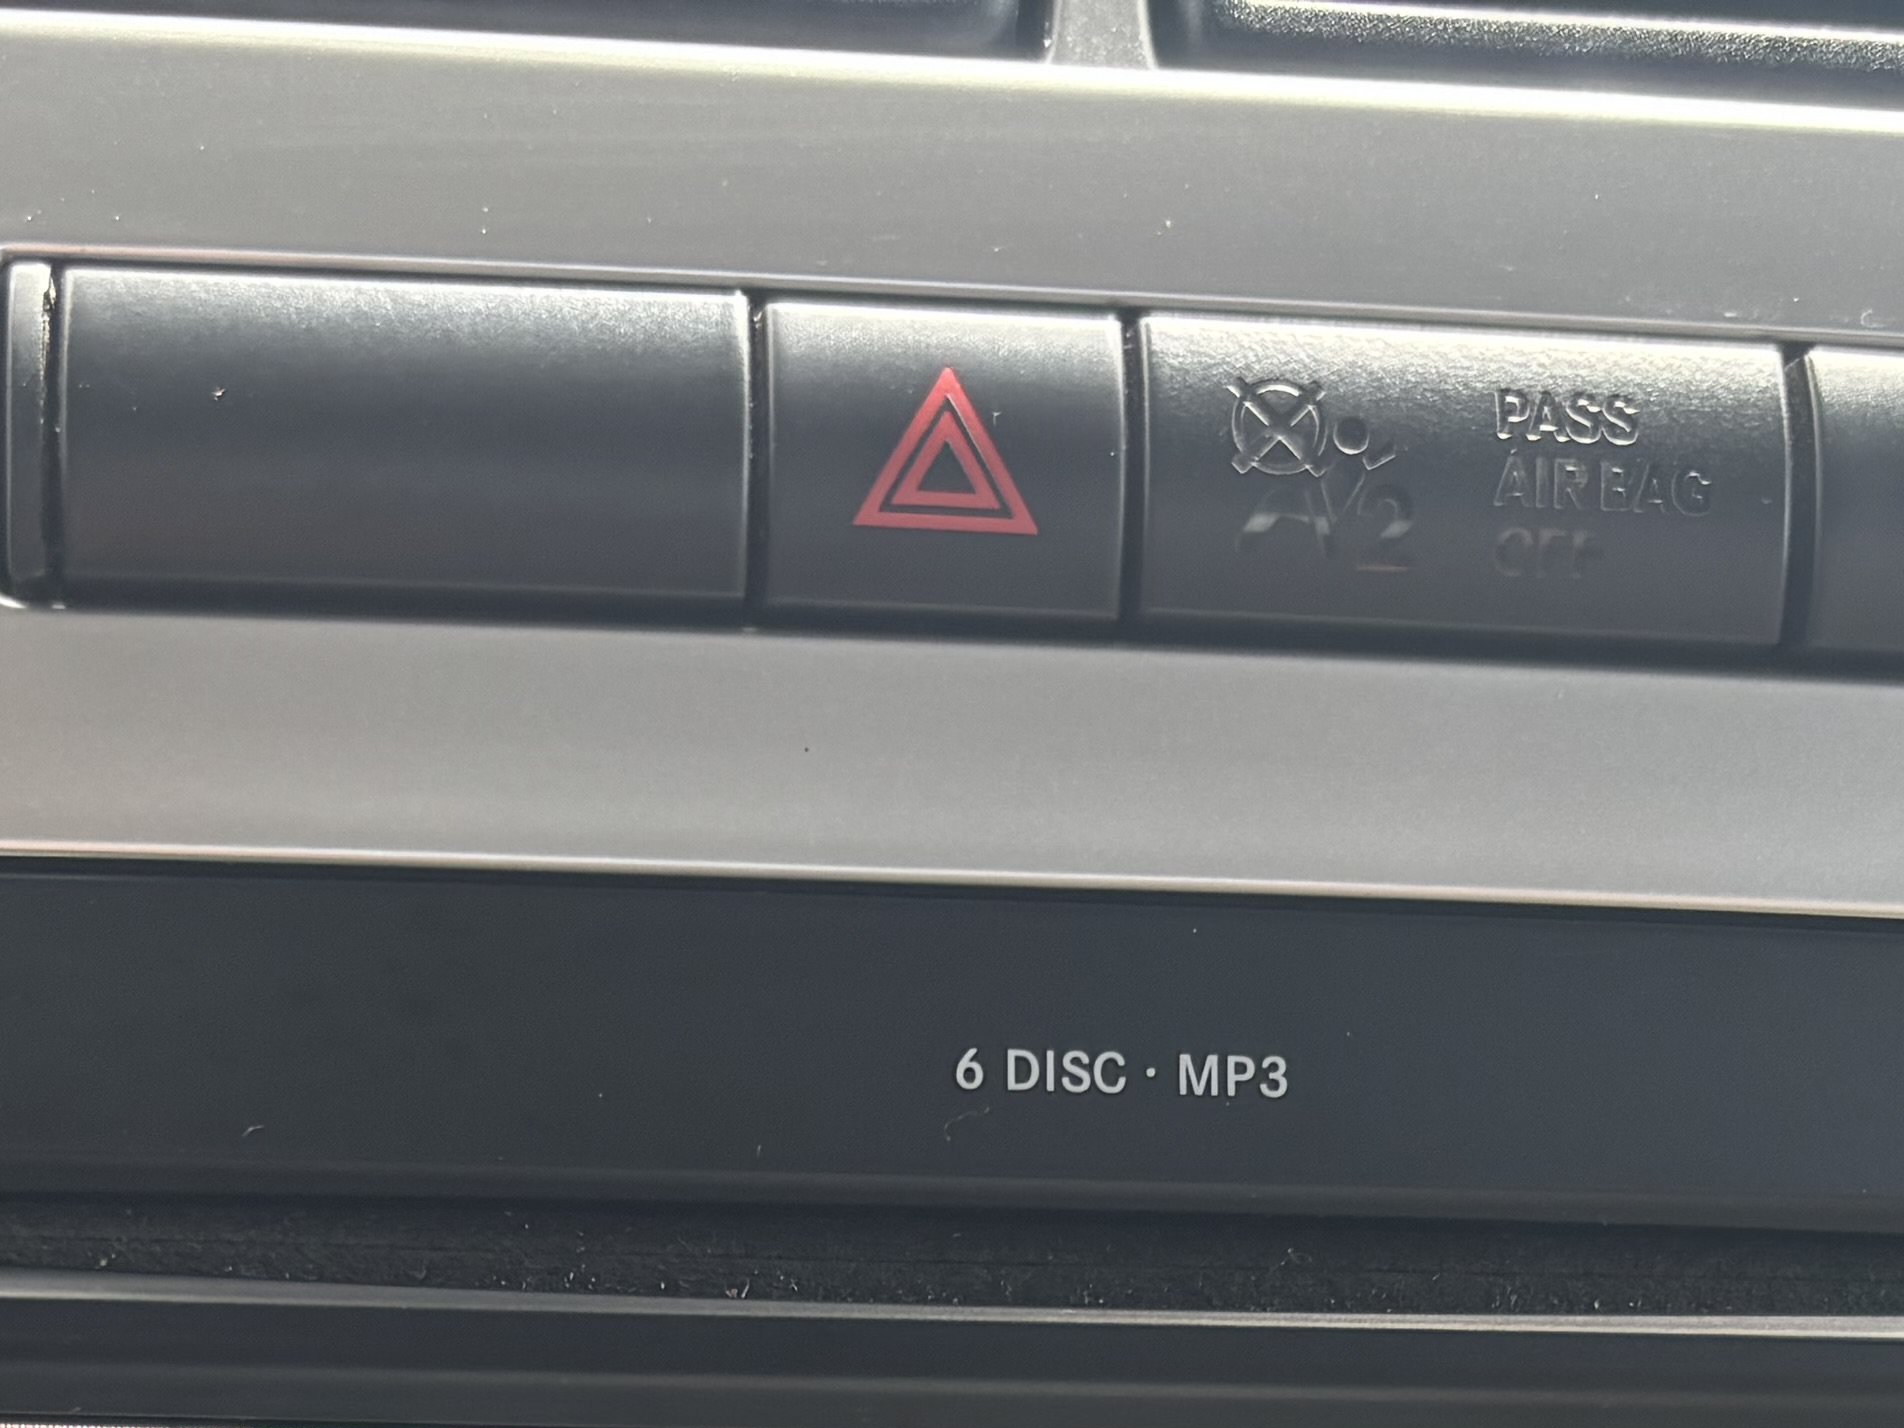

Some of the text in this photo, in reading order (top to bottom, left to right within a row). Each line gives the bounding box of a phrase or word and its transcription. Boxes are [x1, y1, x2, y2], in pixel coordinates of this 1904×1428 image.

[1495, 389, 1639, 446] PASS
[1493, 452, 1712, 517] AIRBAG
[955, 1048, 984, 1091] 6
[1006, 1048, 1128, 1095] DISC
[1177, 1054, 1290, 1099] MP3
